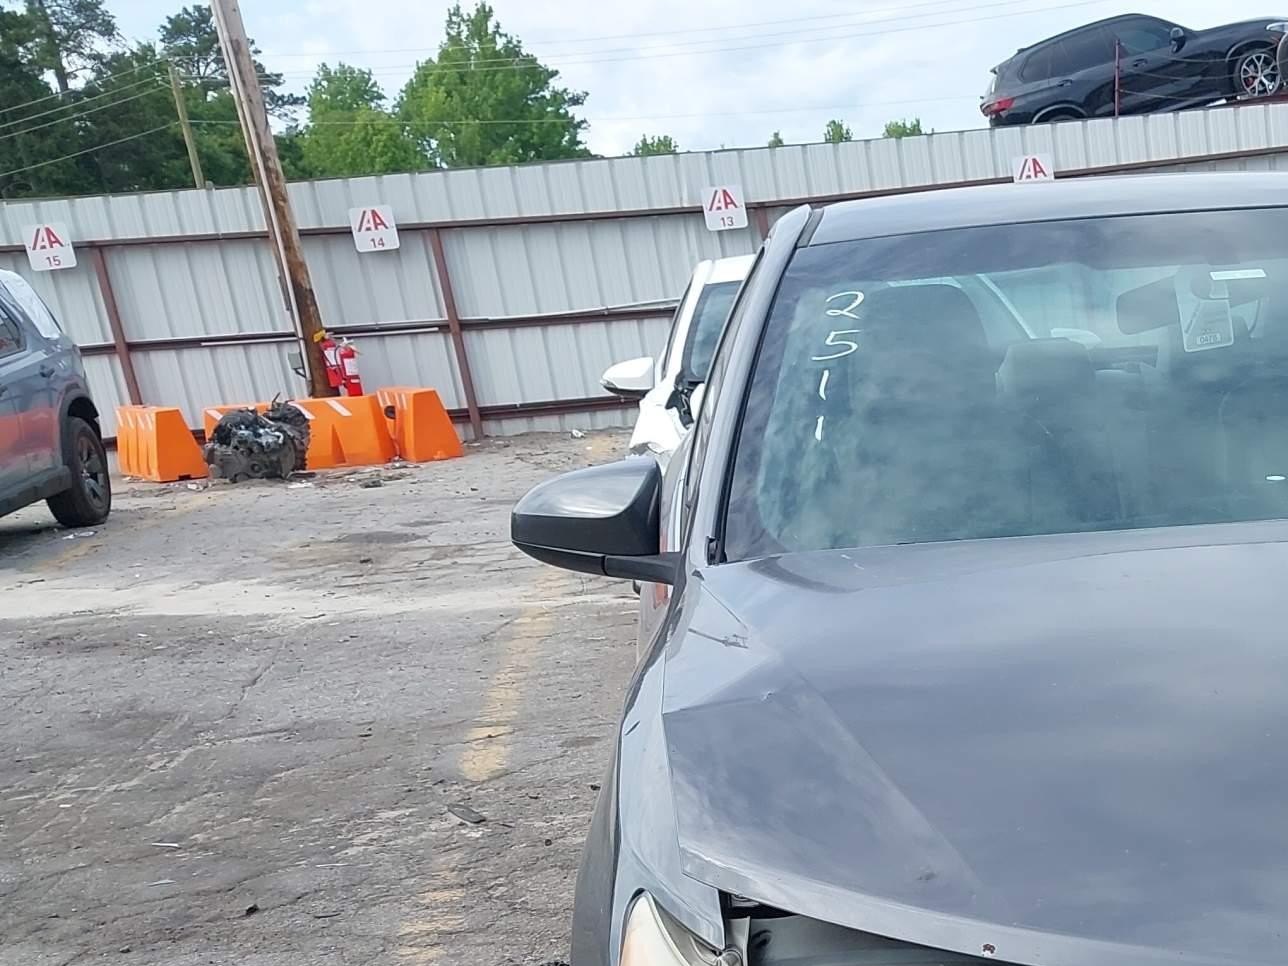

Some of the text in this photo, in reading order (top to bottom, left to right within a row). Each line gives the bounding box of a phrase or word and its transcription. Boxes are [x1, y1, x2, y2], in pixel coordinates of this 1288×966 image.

[720, 216, 735, 227] 13
[369, 237, 385, 249] 14
[45, 255, 62, 267] 15
